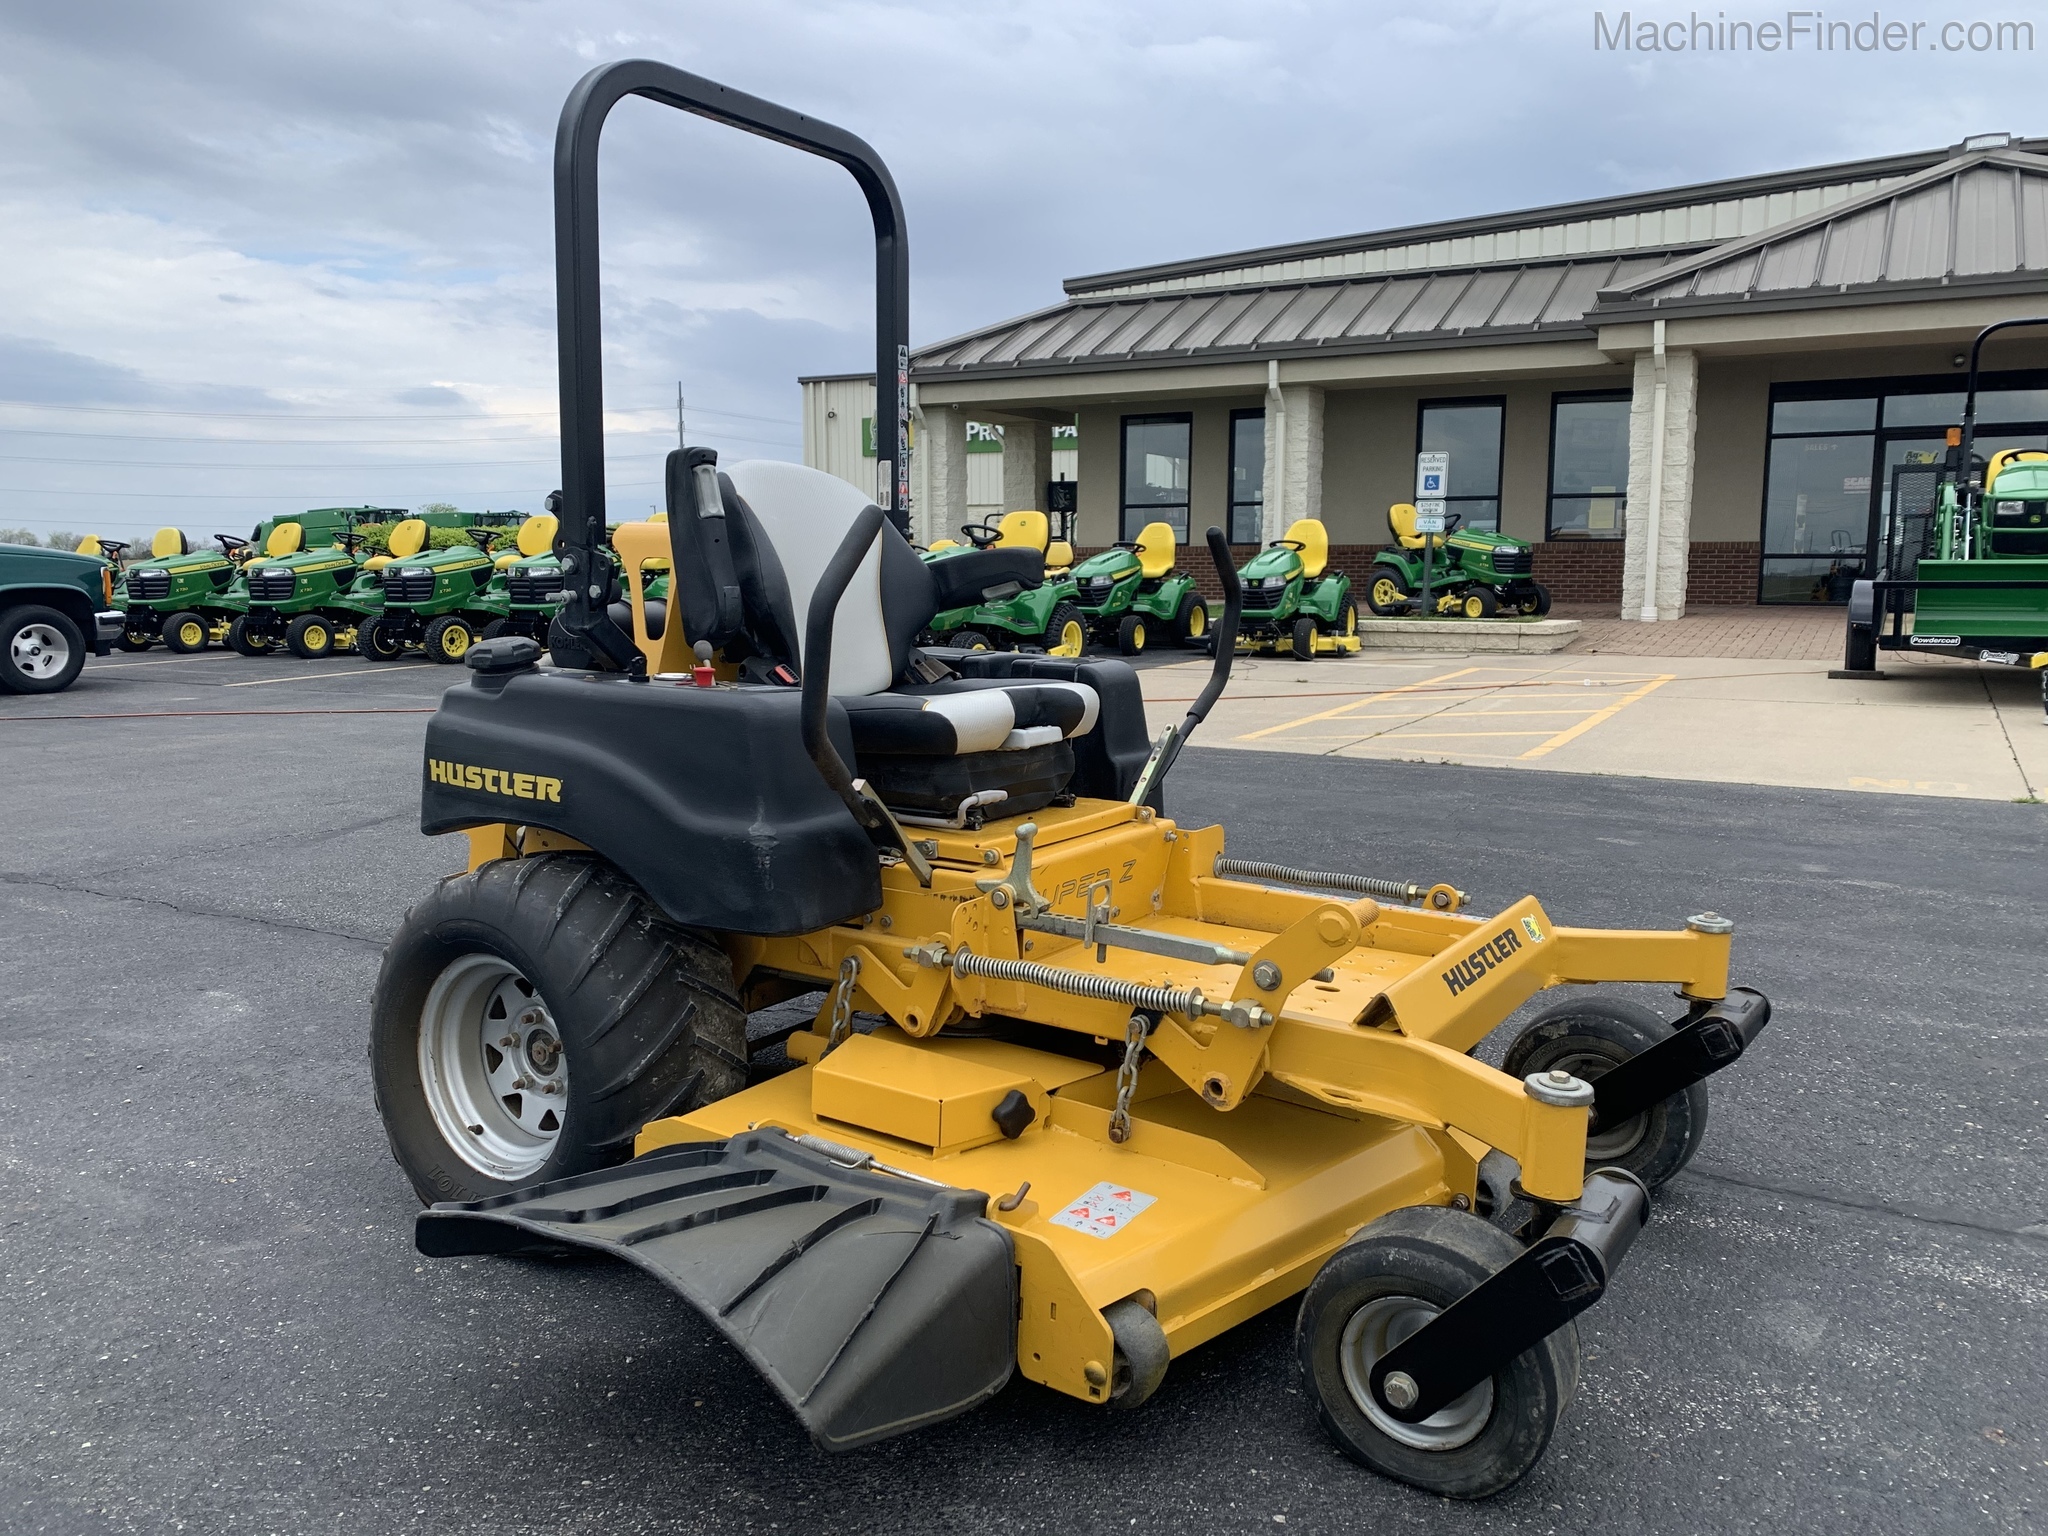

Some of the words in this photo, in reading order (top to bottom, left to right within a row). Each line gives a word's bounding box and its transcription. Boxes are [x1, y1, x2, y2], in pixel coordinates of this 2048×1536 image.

[1912, 637, 1959, 645] Powdercoat
[429, 758, 563, 803] HUSTLER
[1119, 859, 1137, 884] Z
[1441, 928, 1522, 997] HUSTLER
